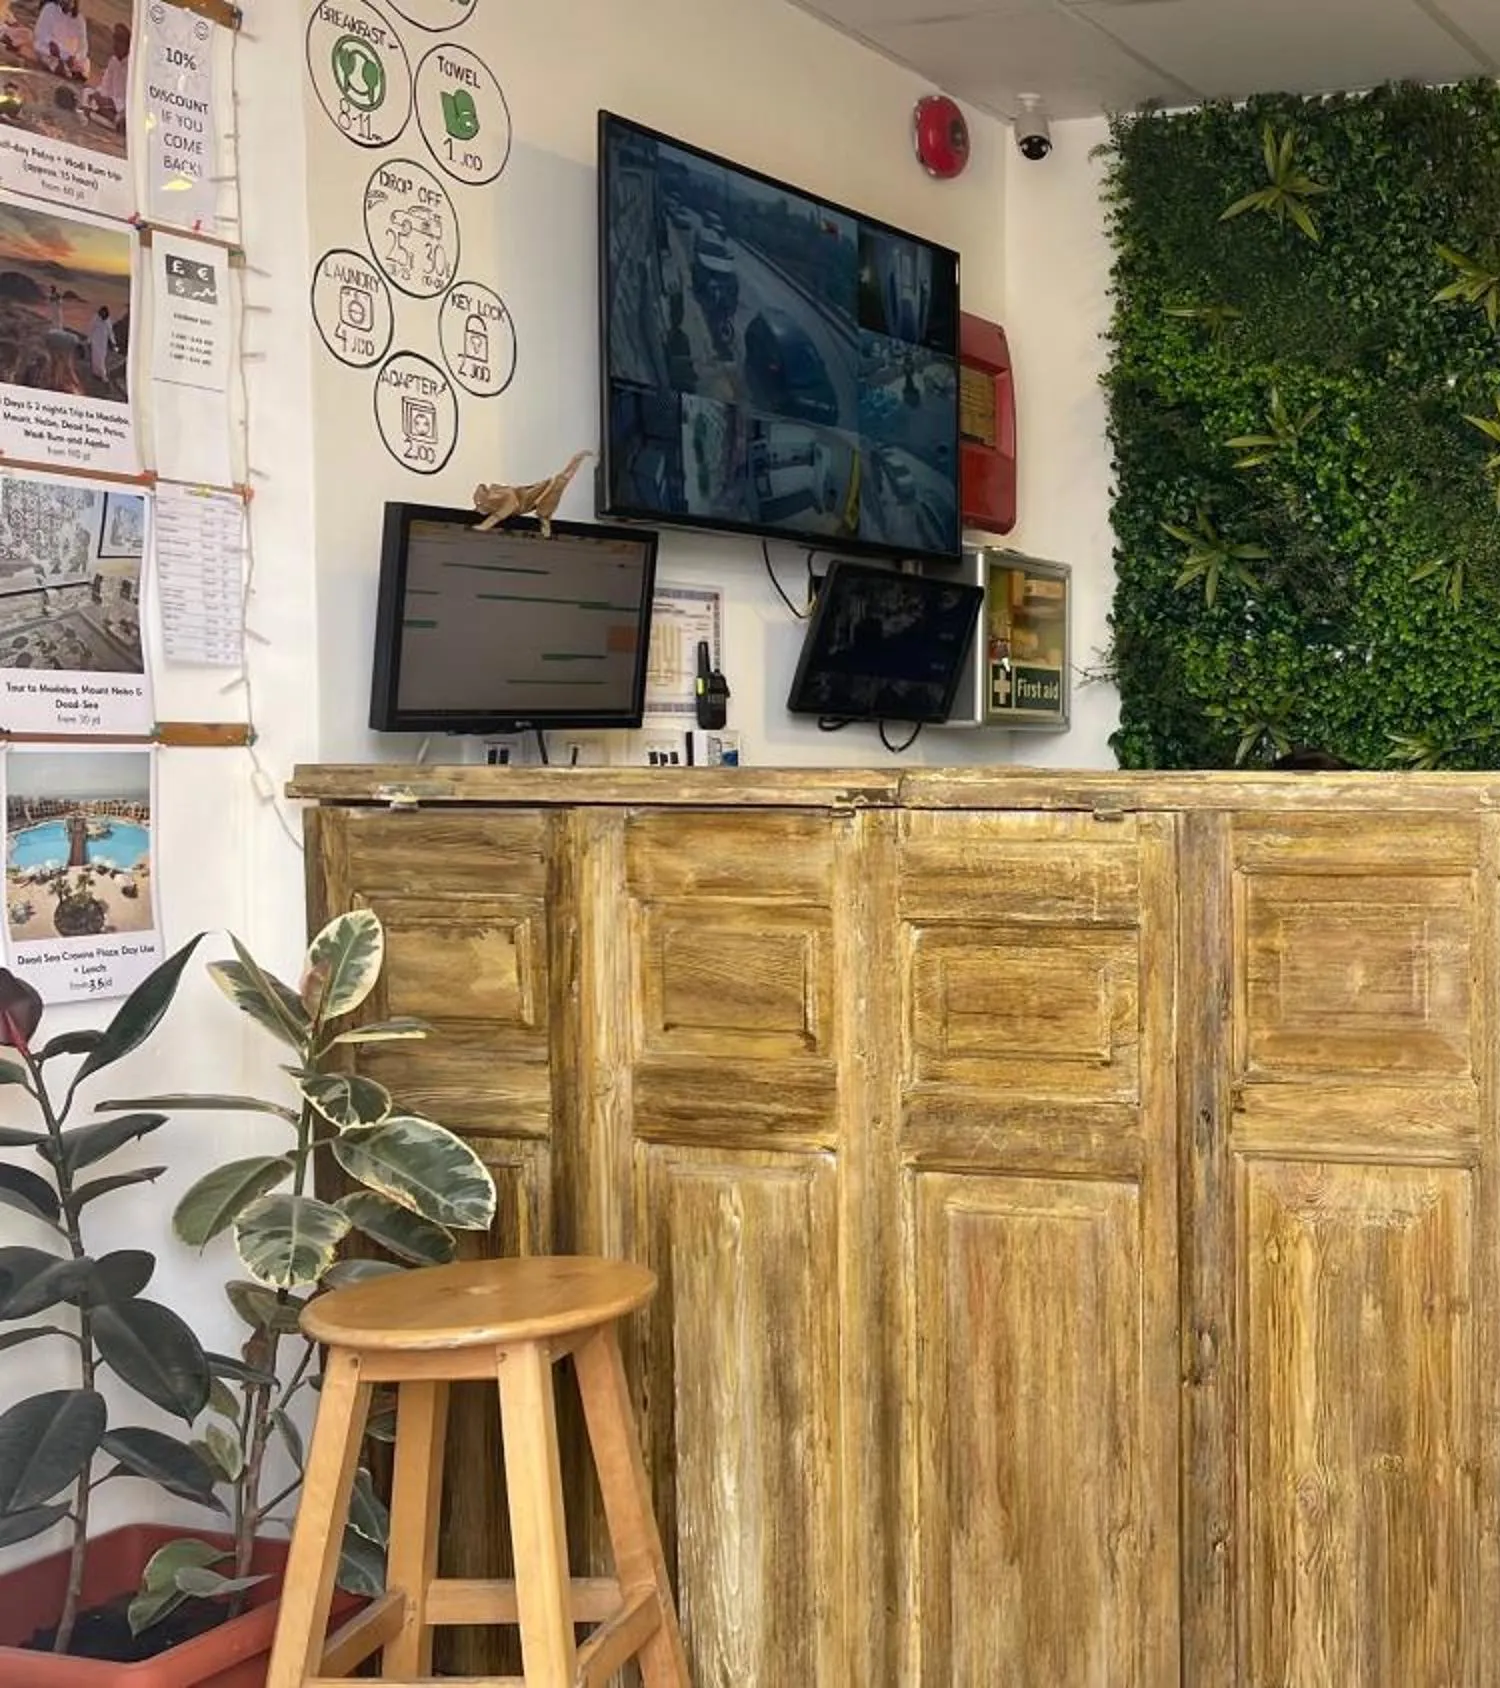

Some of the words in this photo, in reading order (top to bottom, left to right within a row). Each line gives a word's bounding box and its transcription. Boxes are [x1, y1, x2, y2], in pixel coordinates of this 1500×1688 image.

[319, 5, 387, 46] BREAKFAST
[166, 47, 197, 71] 10%
[437, 55, 480, 89] TOWEL
[149, 85, 208, 115] DISCOUNT
[162, 109, 173, 124] IF
[175, 113, 203, 133] YOU
[164, 133, 203, 154] COME
[380, 171, 413, 193] DROP
[418, 187, 442, 206] OFF
[324, 261, 382, 293] LAUNDRY
[451, 292, 473, 312] KEY
[477, 300, 507, 323] LOCK
[380, 367, 438, 397] ADAPTER
[1017, 677, 1041, 699] First
[1043, 680, 1059, 700] aid
